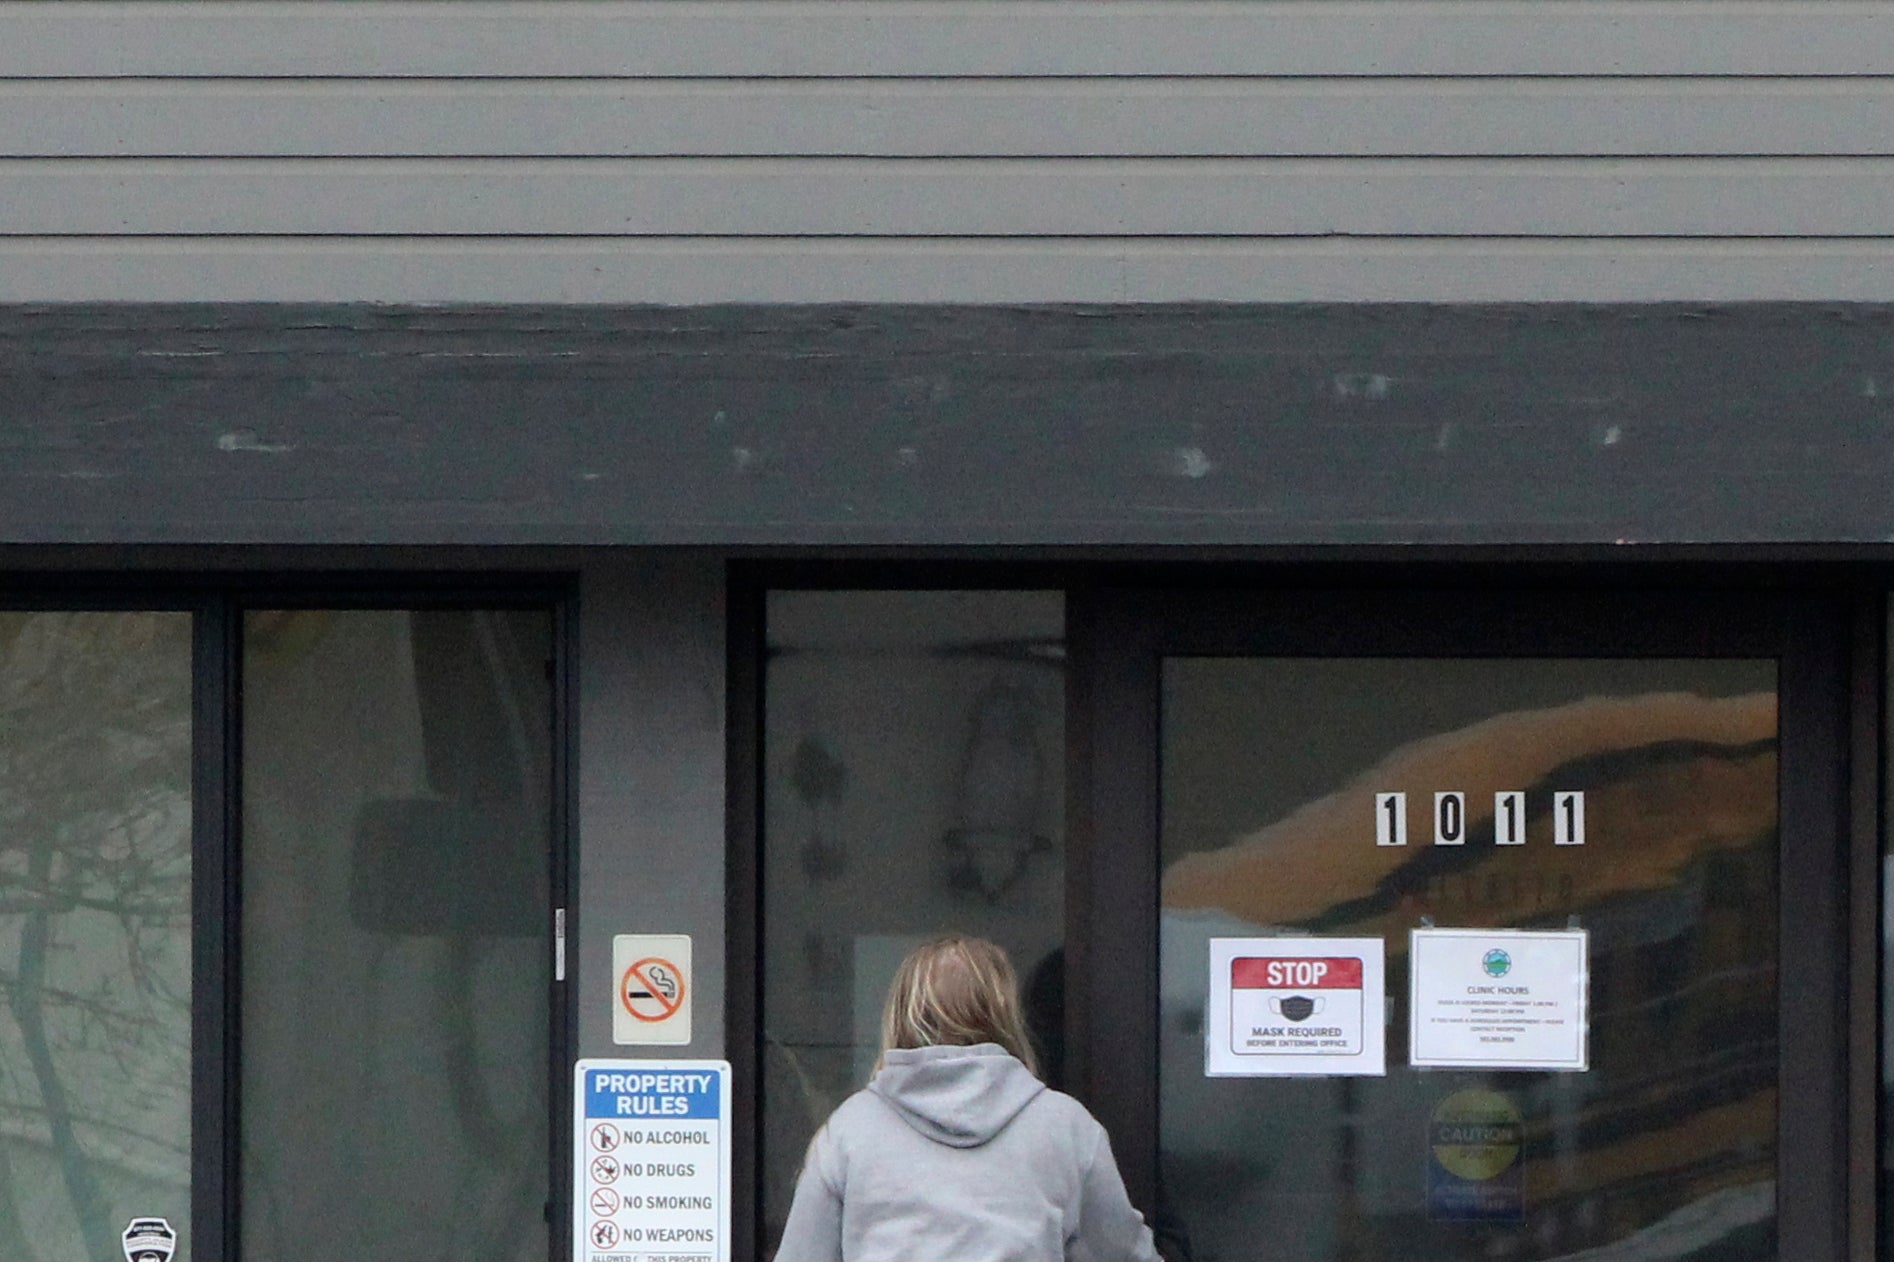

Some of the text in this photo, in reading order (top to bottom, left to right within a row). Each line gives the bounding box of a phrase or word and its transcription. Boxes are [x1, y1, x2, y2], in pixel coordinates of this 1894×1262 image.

[1266, 960, 1328, 986] STOP
[1466, 985, 1530, 996] CLINIC HOURS
[1251, 1026, 1342, 1038] MASK REQUIRED
[594, 1073, 712, 1094] PROPERTY
[616, 1096, 689, 1115] RULES
[623, 1130, 711, 1145] NO ALCOHOL
[623, 1163, 696, 1177] NO DRUGS
[623, 1195, 713, 1210] NO SMOKING
[623, 1228, 714, 1242] NO WEAPONS
